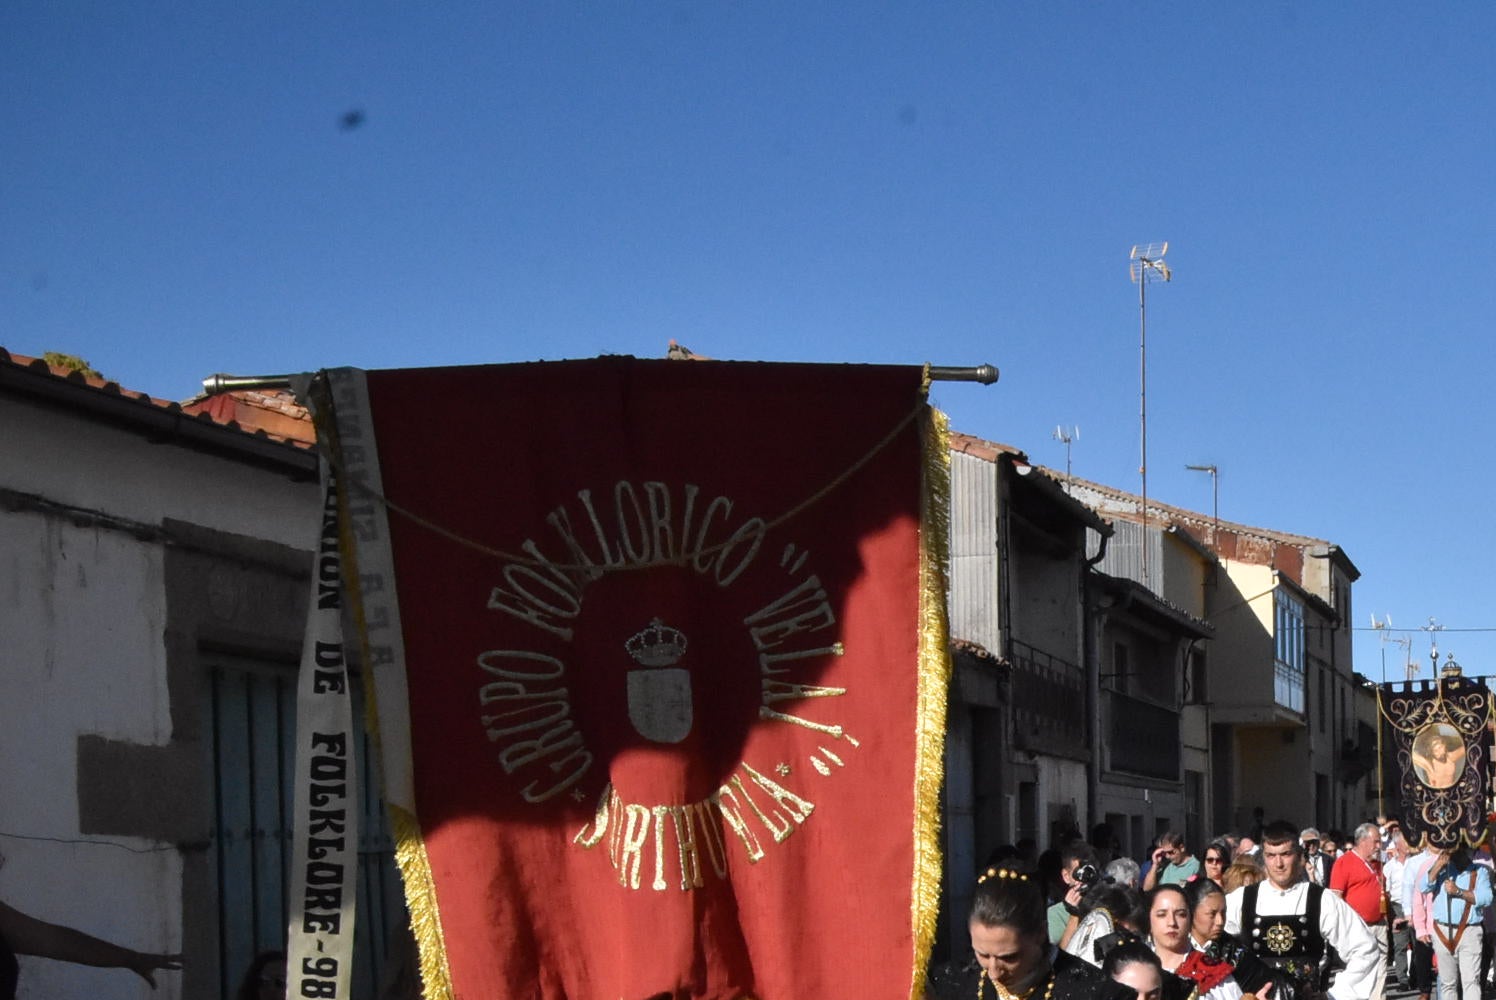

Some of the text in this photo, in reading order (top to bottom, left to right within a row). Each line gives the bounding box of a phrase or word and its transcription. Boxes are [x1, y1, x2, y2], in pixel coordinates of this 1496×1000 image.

[487, 480, 766, 642] FOLKLORICO
[313, 641, 345, 695] DE
[477, 649, 593, 802] GRUPO
[301, 732, 346, 1000] FOLKLORE-98
